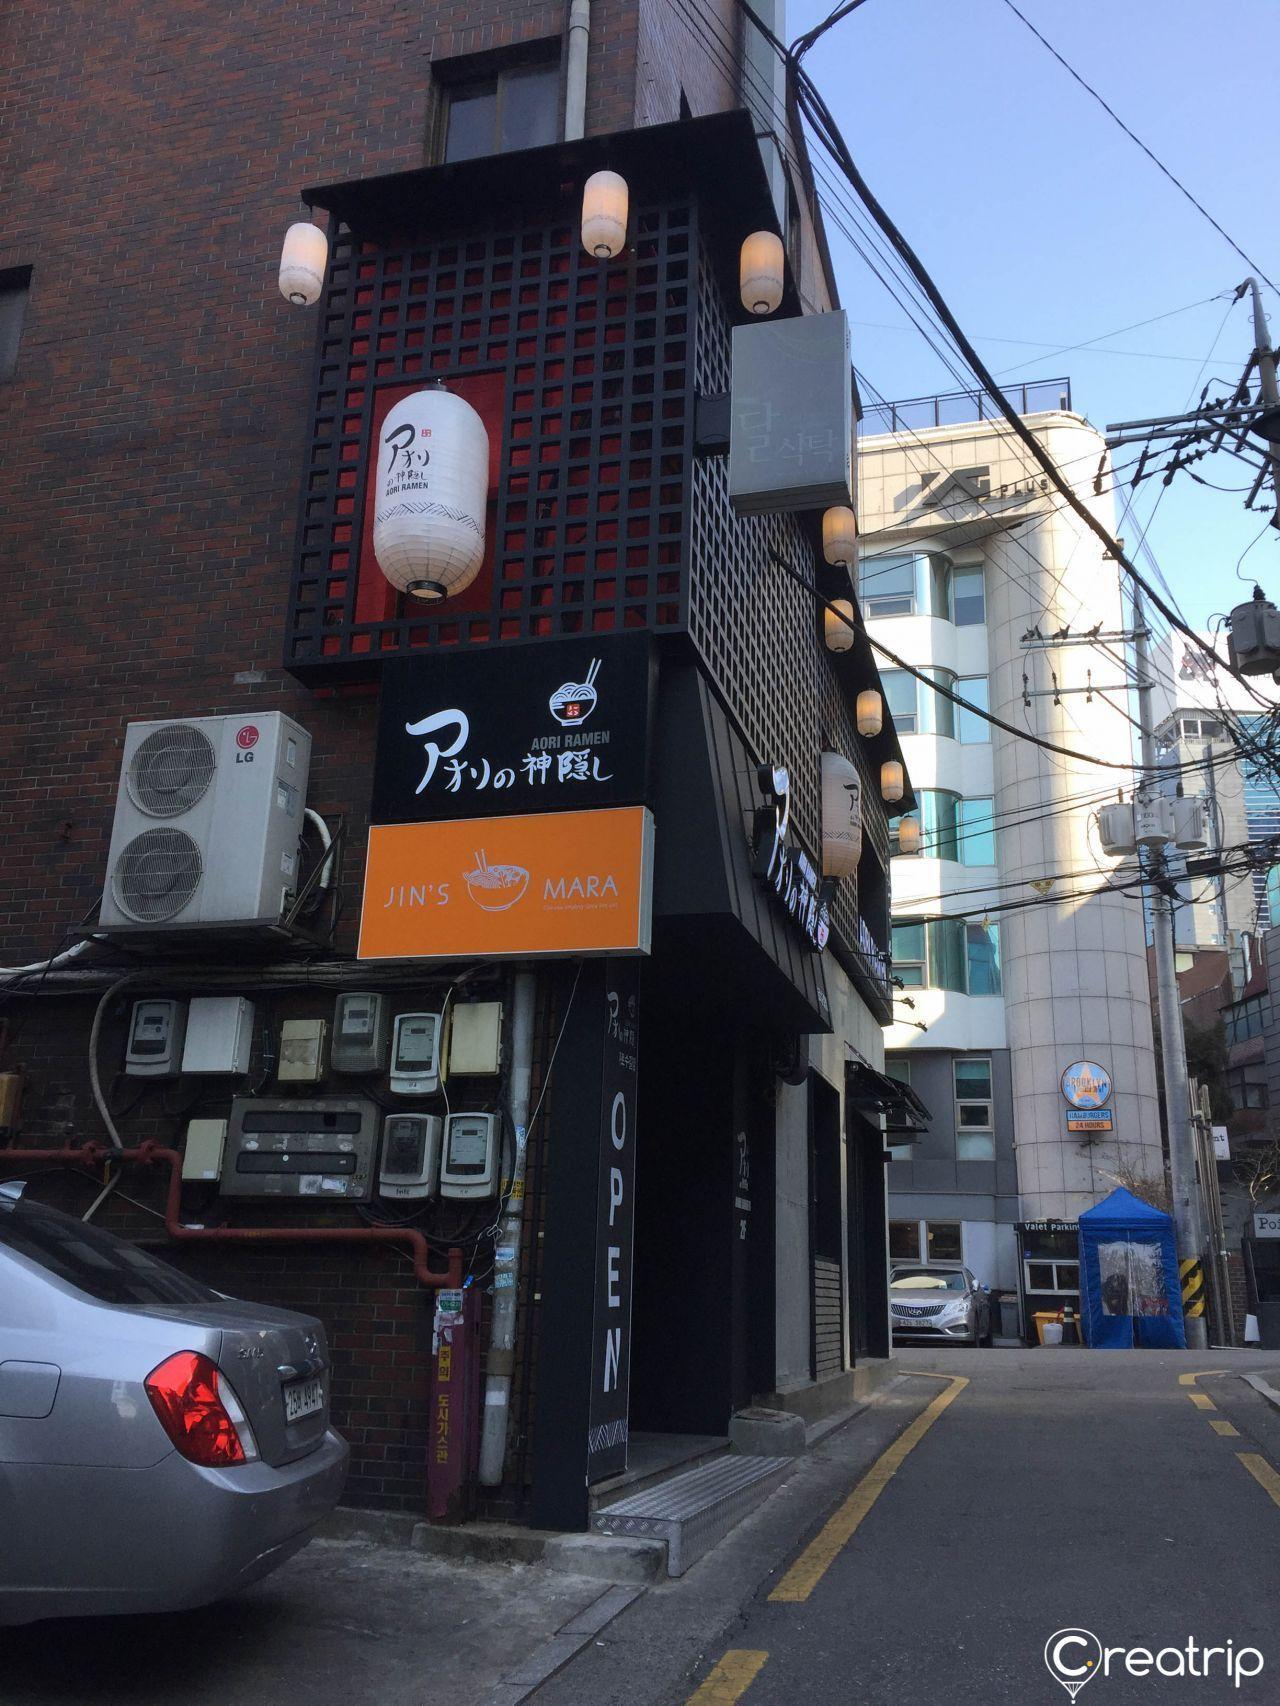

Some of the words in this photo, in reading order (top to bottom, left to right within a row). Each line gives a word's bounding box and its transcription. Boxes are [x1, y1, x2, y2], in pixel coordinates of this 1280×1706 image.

[385, 423, 430, 474] アオリ
[385, 485, 400, 497] AORI
[401, 481, 429, 492] RAMEN
[1000, 478, 1048, 498] PLUS
[531, 735, 560, 751] AORI
[564, 730, 611, 747] RAMEN
[235, 752, 254, 764] LG
[384, 882, 450, 909] JIN'S
[543, 875, 619, 901] MARA
[1084, 1121, 1105, 1129] HOURS
[1024, 1223, 1048, 1231] Valet
[602, 1092, 626, 1393] OPEN
[438, 1350, 450, 1378] 주의
[436, 1393, 450, 1464] 도시가스관
